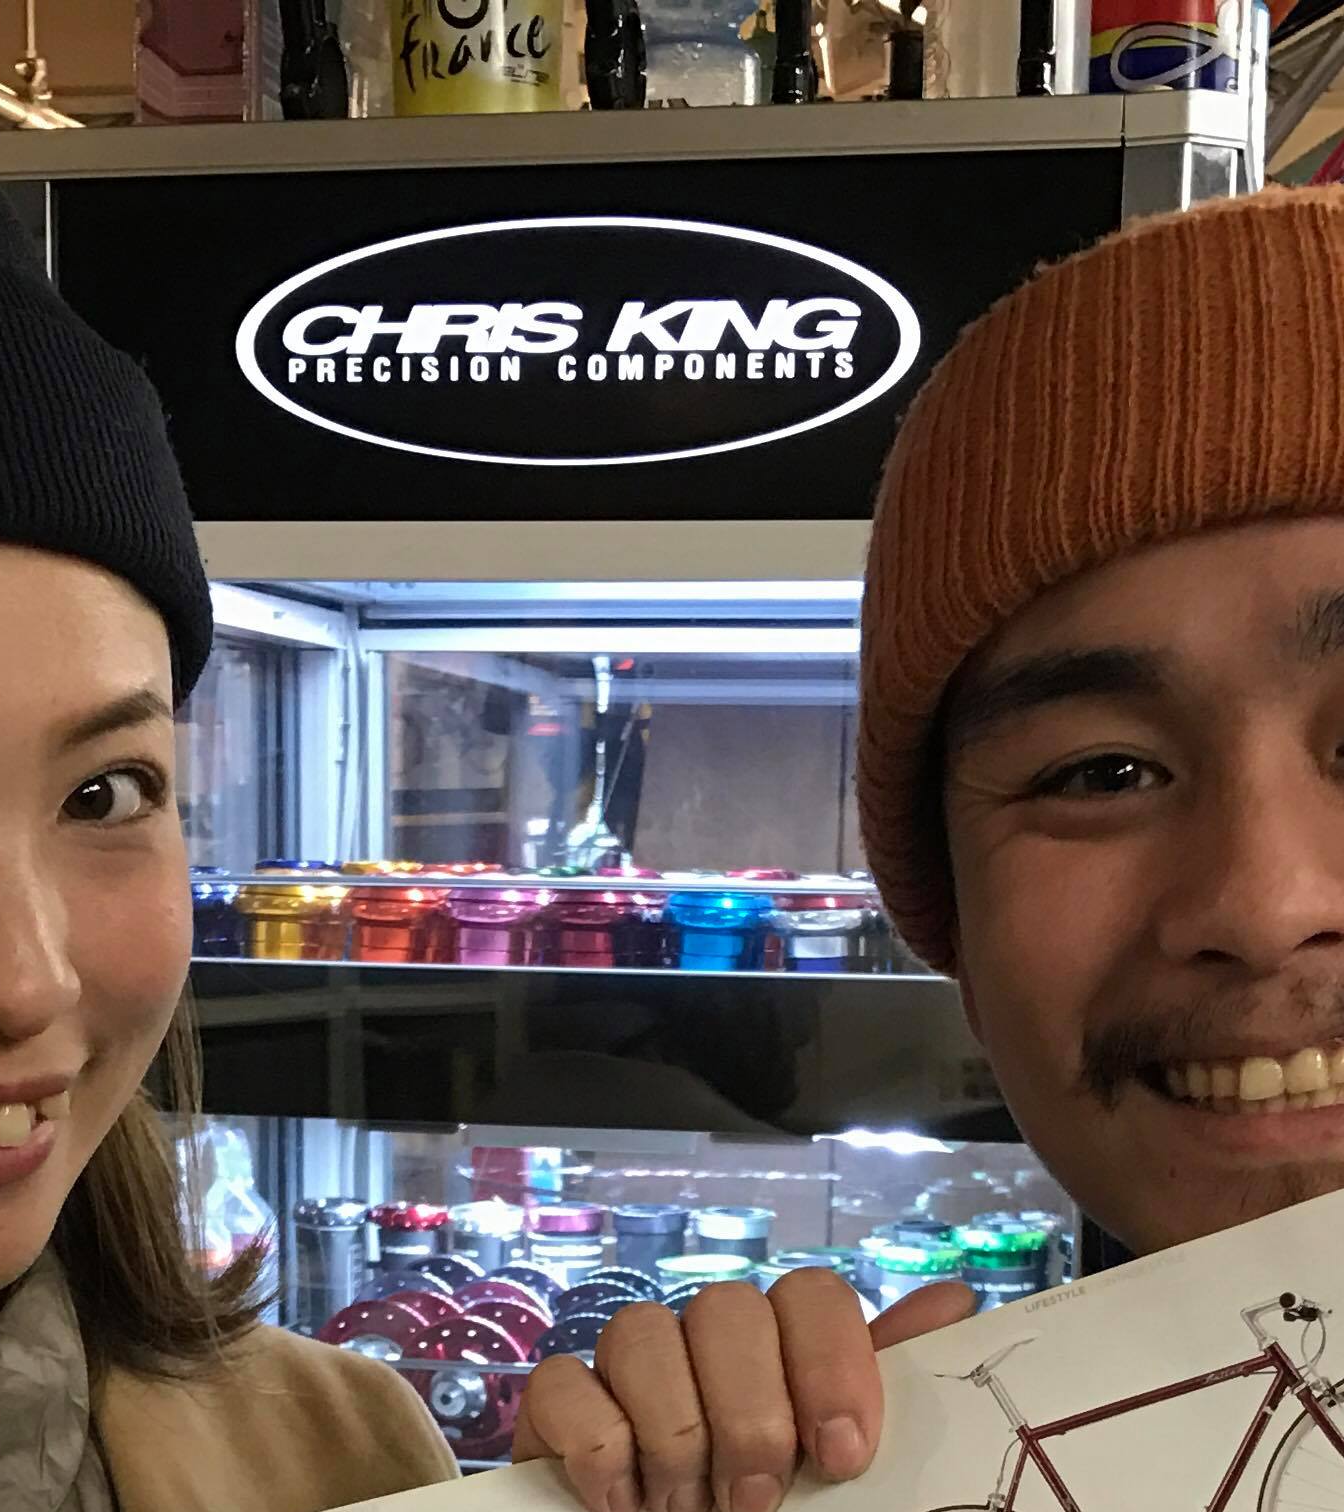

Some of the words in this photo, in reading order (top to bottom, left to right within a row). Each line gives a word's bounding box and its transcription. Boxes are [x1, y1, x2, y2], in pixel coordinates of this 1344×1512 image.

[281, 303, 585, 355] CHRIS
[608, 298, 862, 354] KING
[287, 354, 522, 384] PRECISION
[557, 350, 855, 381] COMPONENTS
[1024, 1285, 1087, 1314] LIFESTYLE
